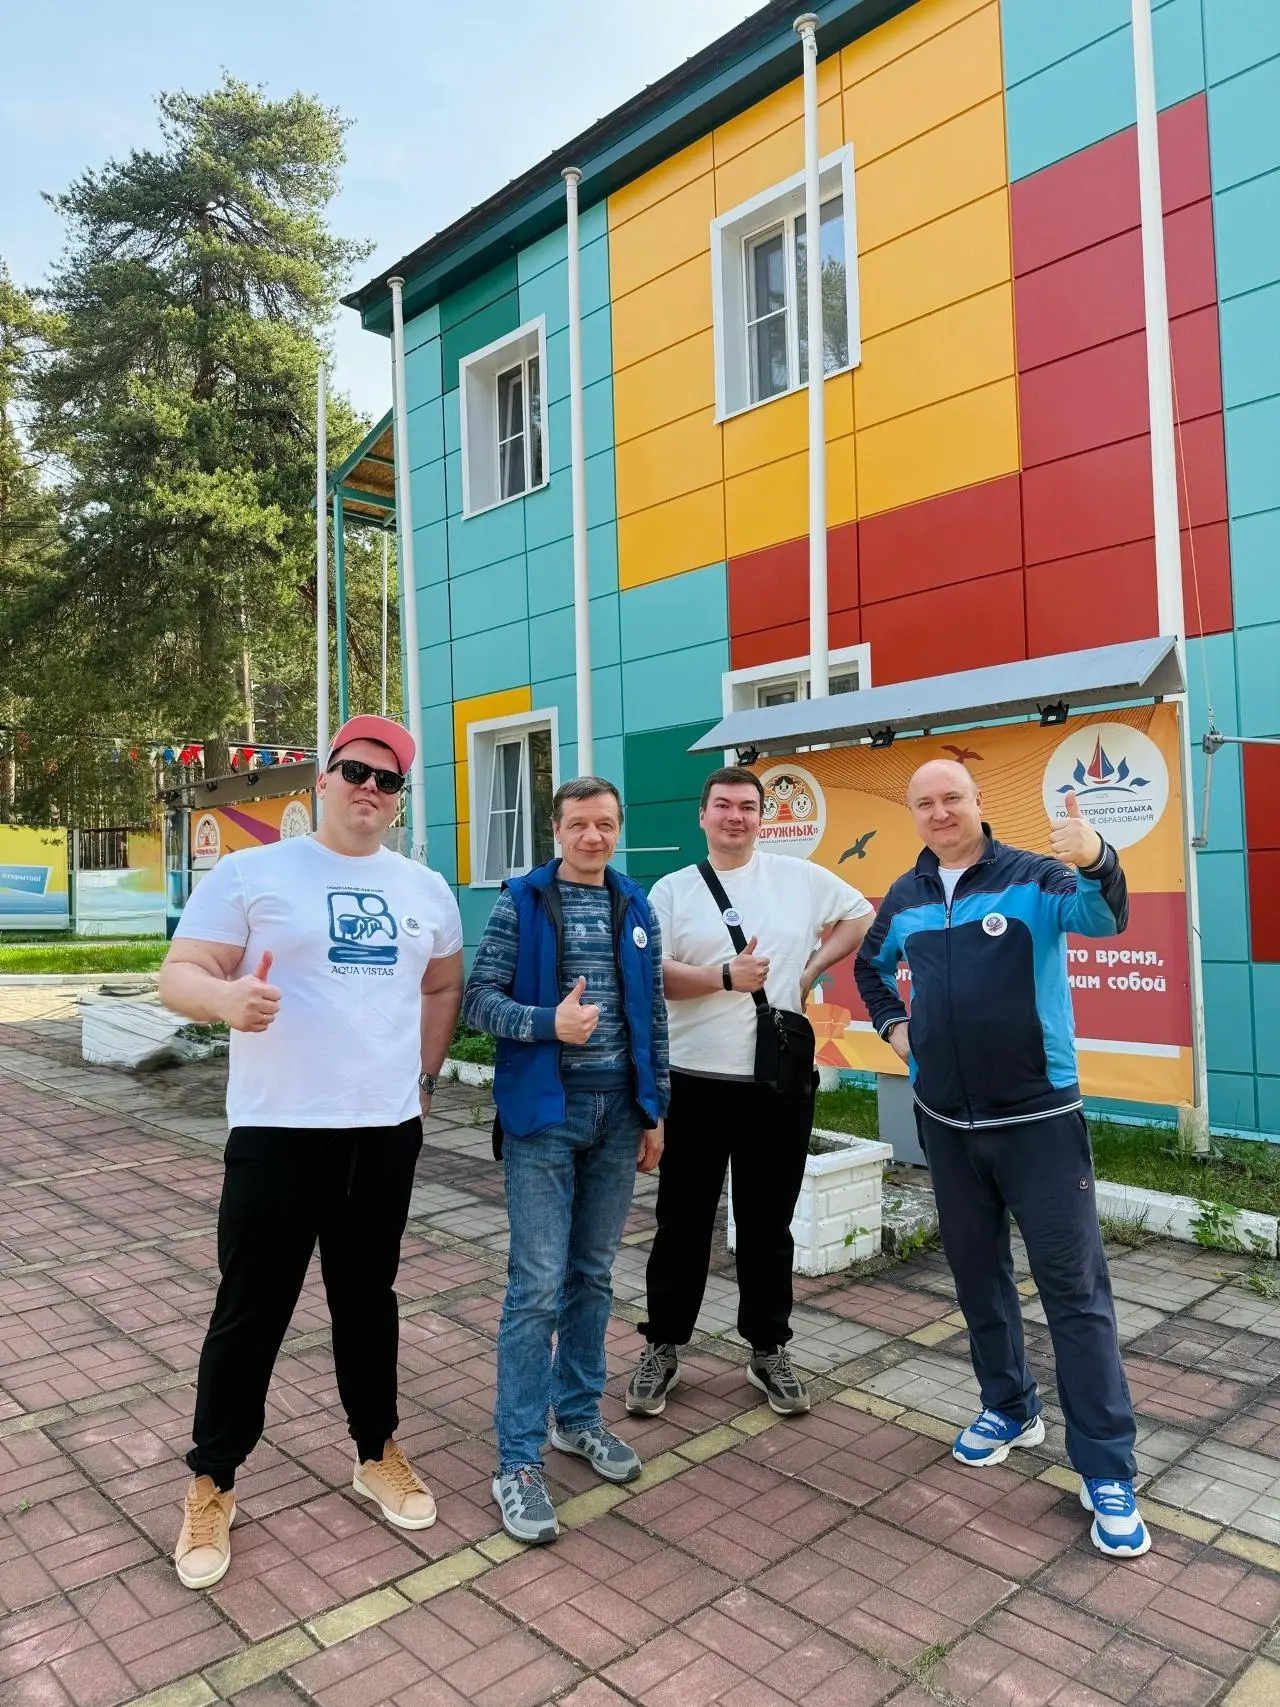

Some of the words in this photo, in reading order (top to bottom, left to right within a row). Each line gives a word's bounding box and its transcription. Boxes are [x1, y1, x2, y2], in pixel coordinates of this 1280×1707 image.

[1080, 807, 1115, 816] ЕТСКОГО
[1117, 804, 1153, 813] ОТДЫХА
[1097, 814, 1154, 825] ОБРАЗОВАНИЯ
[1067, 949, 1089, 963] то
[1095, 949, 1164, 968] время,
[331, 966, 360, 975] AQUA
[362, 967, 394, 976] VISTAS
[1067, 974, 1100, 989] мим
[1107, 971, 1166, 992] собой
